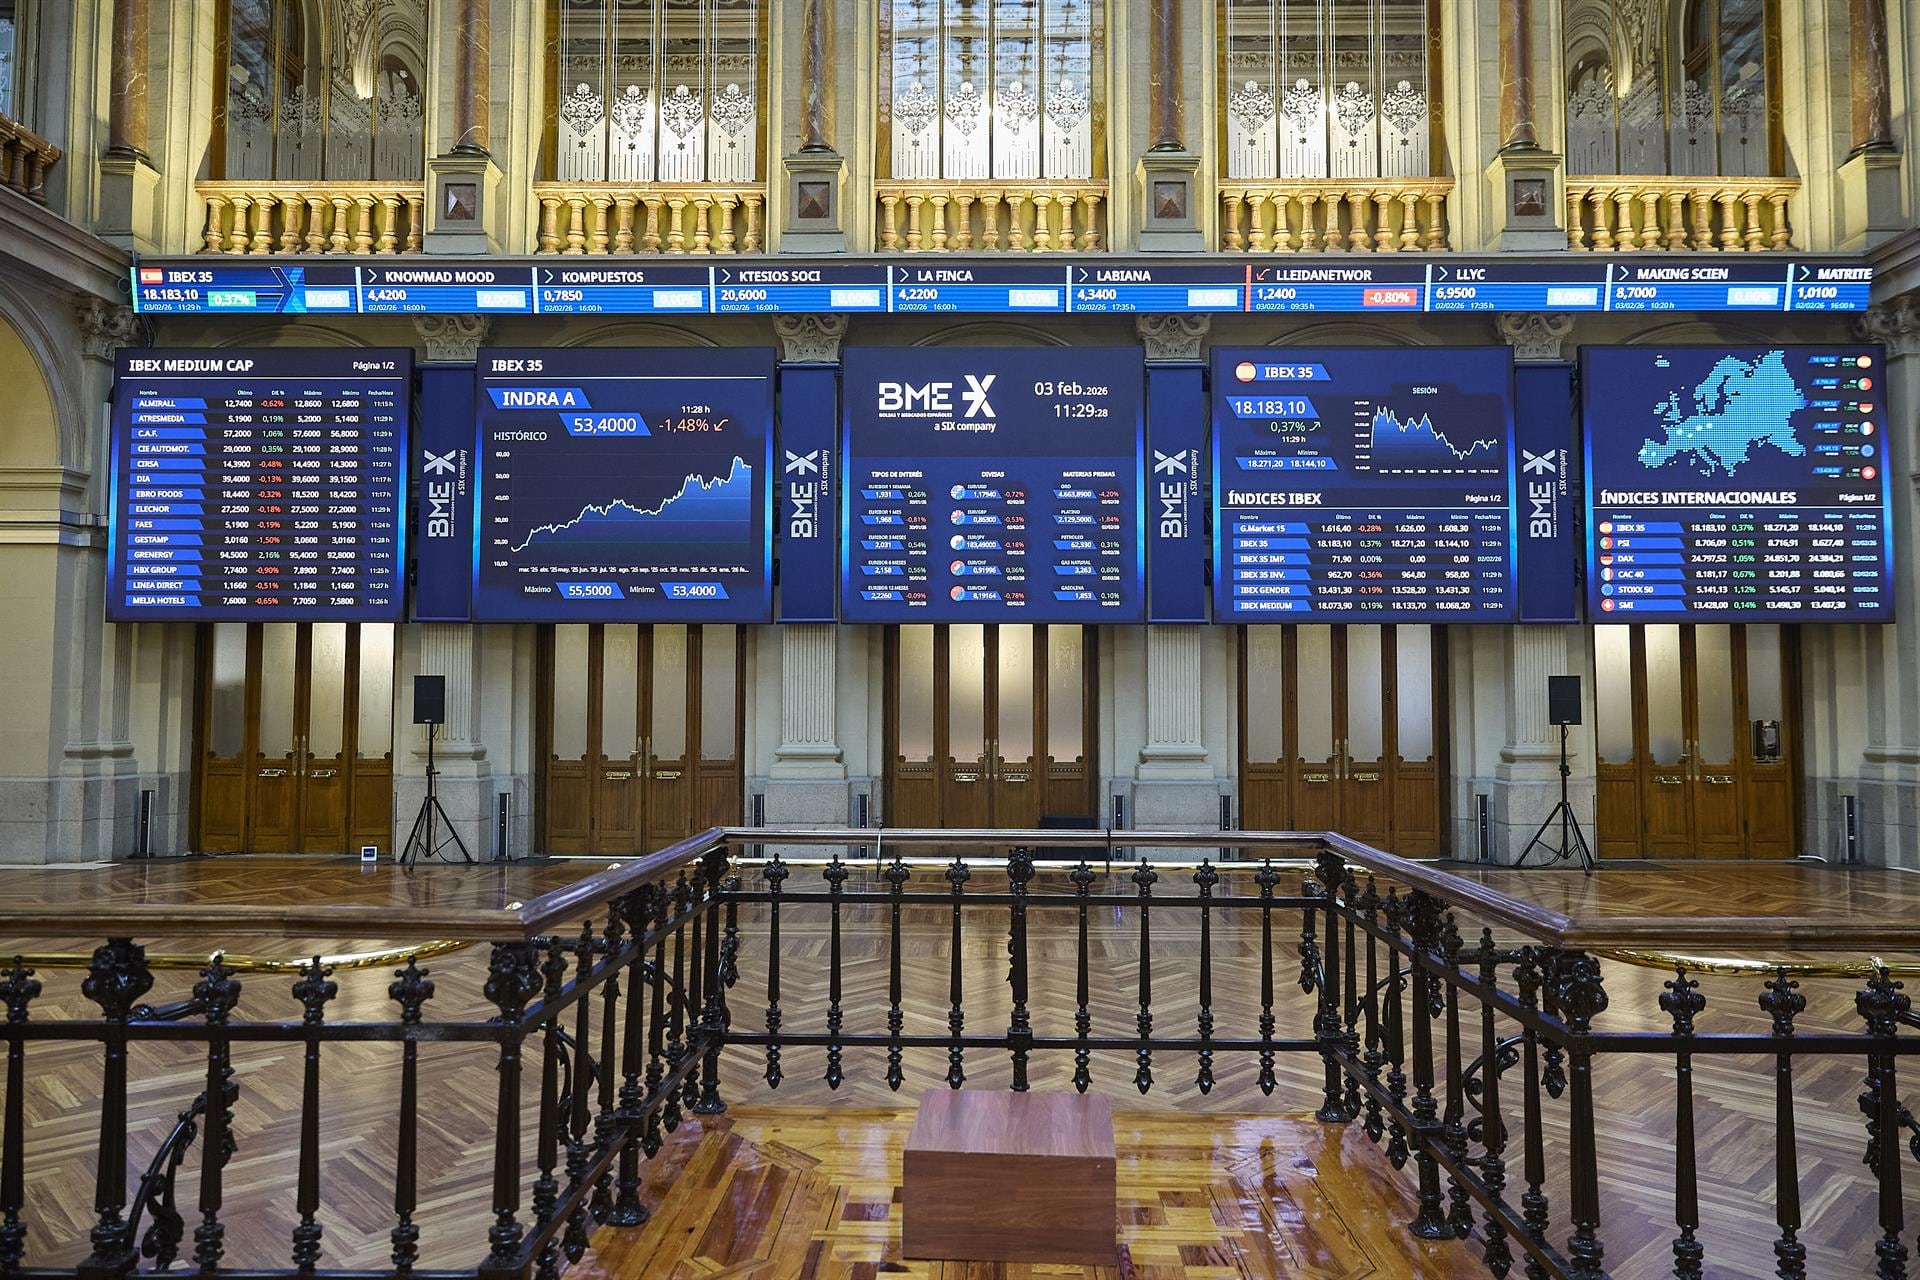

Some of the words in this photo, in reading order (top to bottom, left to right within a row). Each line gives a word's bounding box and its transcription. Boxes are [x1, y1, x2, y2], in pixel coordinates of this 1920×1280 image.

[168, 272, 197, 282] IBEX
[198, 271, 213, 282] 35
[385, 271, 452, 282] KNOWMAD
[455, 272, 495, 282] MOOD
[562, 272, 644, 283] KOMPUESTOS
[739, 271, 789, 282] KTESIOS
[792, 271, 821, 282] SOCI
[918, 271, 934, 281] LA
[936, 271, 973, 281] FINCA
[1097, 271, 1151, 281] LABIANA
[1277, 270, 1372, 281] LLEIDANETWOR
[1457, 269, 1486, 280] LLYC
[1637, 268, 1689, 279] MAKING
[1691, 268, 1728, 279] SCIEN
[1818, 268, 1873, 279] MATRITE
[143, 289, 198, 301] 18.183,10
[368, 290, 406, 302] 4,4200
[544, 290, 583, 302] 0,7850
[721, 289, 767, 301] 20,6000
[899, 288, 938, 301] 4,2200
[1077, 289, 1117, 301] 4,3400
[1257, 288, 1296, 300] 1,2400
[1370, 292, 1410, 304] -0,80%
[1436, 287, 1476, 299] 6,9500
[1616, 287, 1657, 299] 8,7000
[1798, 287, 1837, 299] 1,0100
[214, 294, 251, 305] 0,37%
[129, 360, 161, 371] IBEX
[164, 360, 223, 371] MEDIUM
[226, 360, 254, 371] CAP
[353, 361, 380, 371] Página
[382, 361, 395, 369] 1/2
[492, 360, 524, 371] IBEX
[526, 360, 543, 371] 35
[1265, 367, 1295, 378] IBEX
[1298, 367, 1313, 378] 35
[1035, 382, 1053, 395] 03
[1057, 381, 1108, 395] feb.2026
[1412, 386, 1437, 394] SESIÓN
[503, 392, 559, 406] INDRA
[563, 392, 576, 406] A
[879, 382, 952, 410] BME
[225, 400, 252, 408] 12,7400
[682, 405, 703, 413] 11:28
[704, 405, 710, 413] h
[1235, 401, 1305, 416] 18.183,10
[1054, 404, 1108, 417] 11:29:28
[228, 415, 252, 423] 5,1900
[574, 418, 636, 434] 53,4000
[659, 418, 709, 433] -1,48%
[934, 423, 940, 431] a
[941, 421, 956, 431] SIX
[957, 423, 996, 433] company
[1270, 421, 1306, 433] 0,37%
[224, 430, 252, 438] 57,2000
[494, 430, 547, 441] HISTÓRICO
[223, 445, 251, 453] 29,0000
[223, 460, 251, 468] 14,3900
[459, 449, 467, 479] company
[822, 449, 830, 479] company
[1191, 449, 1199, 479] company
[1248, 460, 1283, 468] 18.271,20
[1291, 460, 1326, 468] 18.144,10
[222, 475, 250, 483] 39,4000
[1559, 479, 1567, 490] SIX
[222, 490, 250, 498] 18,4400
[1228, 490, 1286, 505] ÍNDICES
[1288, 493, 1322, 504] IBEX
[1465, 495, 1488, 503] Página
[1600, 490, 1659, 504] ÍNDICES
[1661, 492, 1797, 504] INTERNACIONALES
[1839, 494, 1863, 503] Página
[221, 505, 249, 513] 27,2500
[428, 482, 450, 537] BME
[791, 482, 812, 537] BME
[1160, 482, 1182, 538] BME
[1529, 482, 1551, 537] BME
[225, 521, 249, 529] 5,1900
[224, 536, 248, 544] 3,0160
[220, 551, 248, 559] 94,5000
[1259, 555, 1268, 563] 35
[1269, 555, 1285, 563] IMP.
[224, 567, 248, 575] 7,7400
[224, 582, 247, 590] 1,1660
[569, 586, 612, 597] 55,5000
[673, 586, 716, 597] 53,4000
[223, 597, 246, 605] 7,6000
